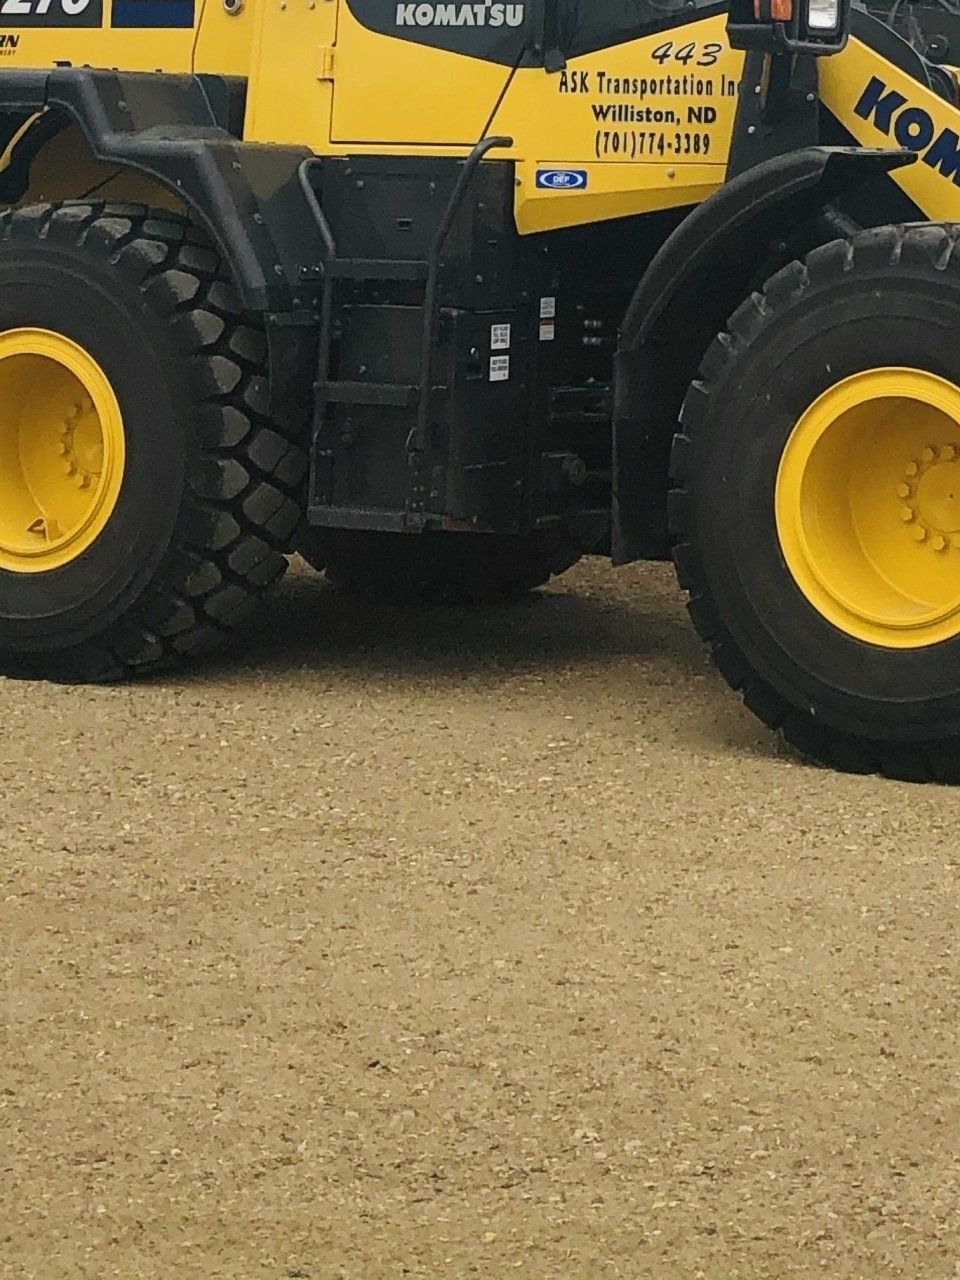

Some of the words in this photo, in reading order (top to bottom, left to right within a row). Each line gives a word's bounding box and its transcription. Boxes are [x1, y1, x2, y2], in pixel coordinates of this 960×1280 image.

[651, 41, 722, 67] 443
[559, 70, 589, 94] ASK
[597, 71, 713, 100] Transportation
[592, 104, 681, 125] Williston,
[687, 106, 717, 124] ND
[595, 130, 711, 158] (701)774-3389
[552, 175, 570, 183] DEF
